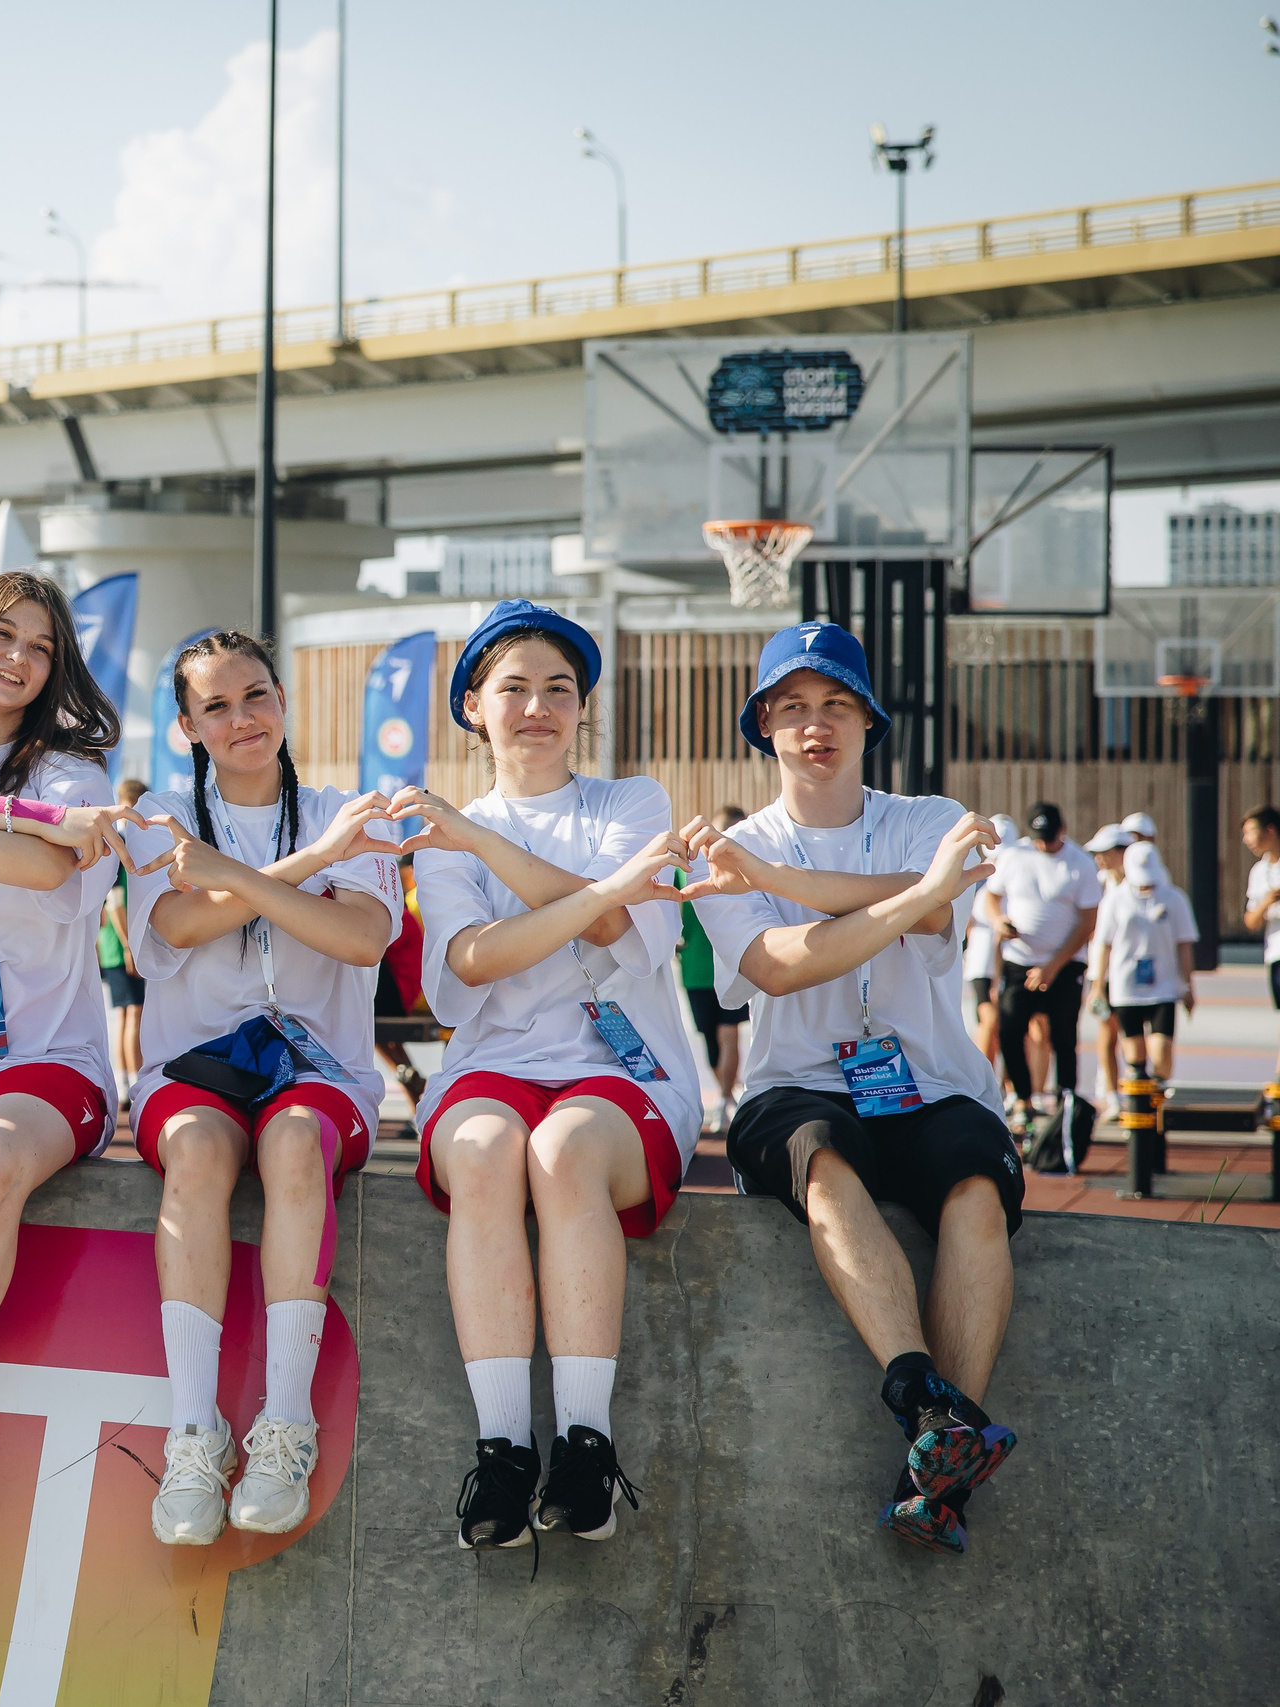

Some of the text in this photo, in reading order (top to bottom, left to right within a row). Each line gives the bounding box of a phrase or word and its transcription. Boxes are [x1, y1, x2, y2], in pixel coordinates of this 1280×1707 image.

[794, 844, 807, 865] Первые
[854, 1065, 890, 1075] ВЫЗОВ
[851, 1073, 893, 1082] ПЕРВЫХ
[861, 1087, 907, 1096] УЧАСТНИК
